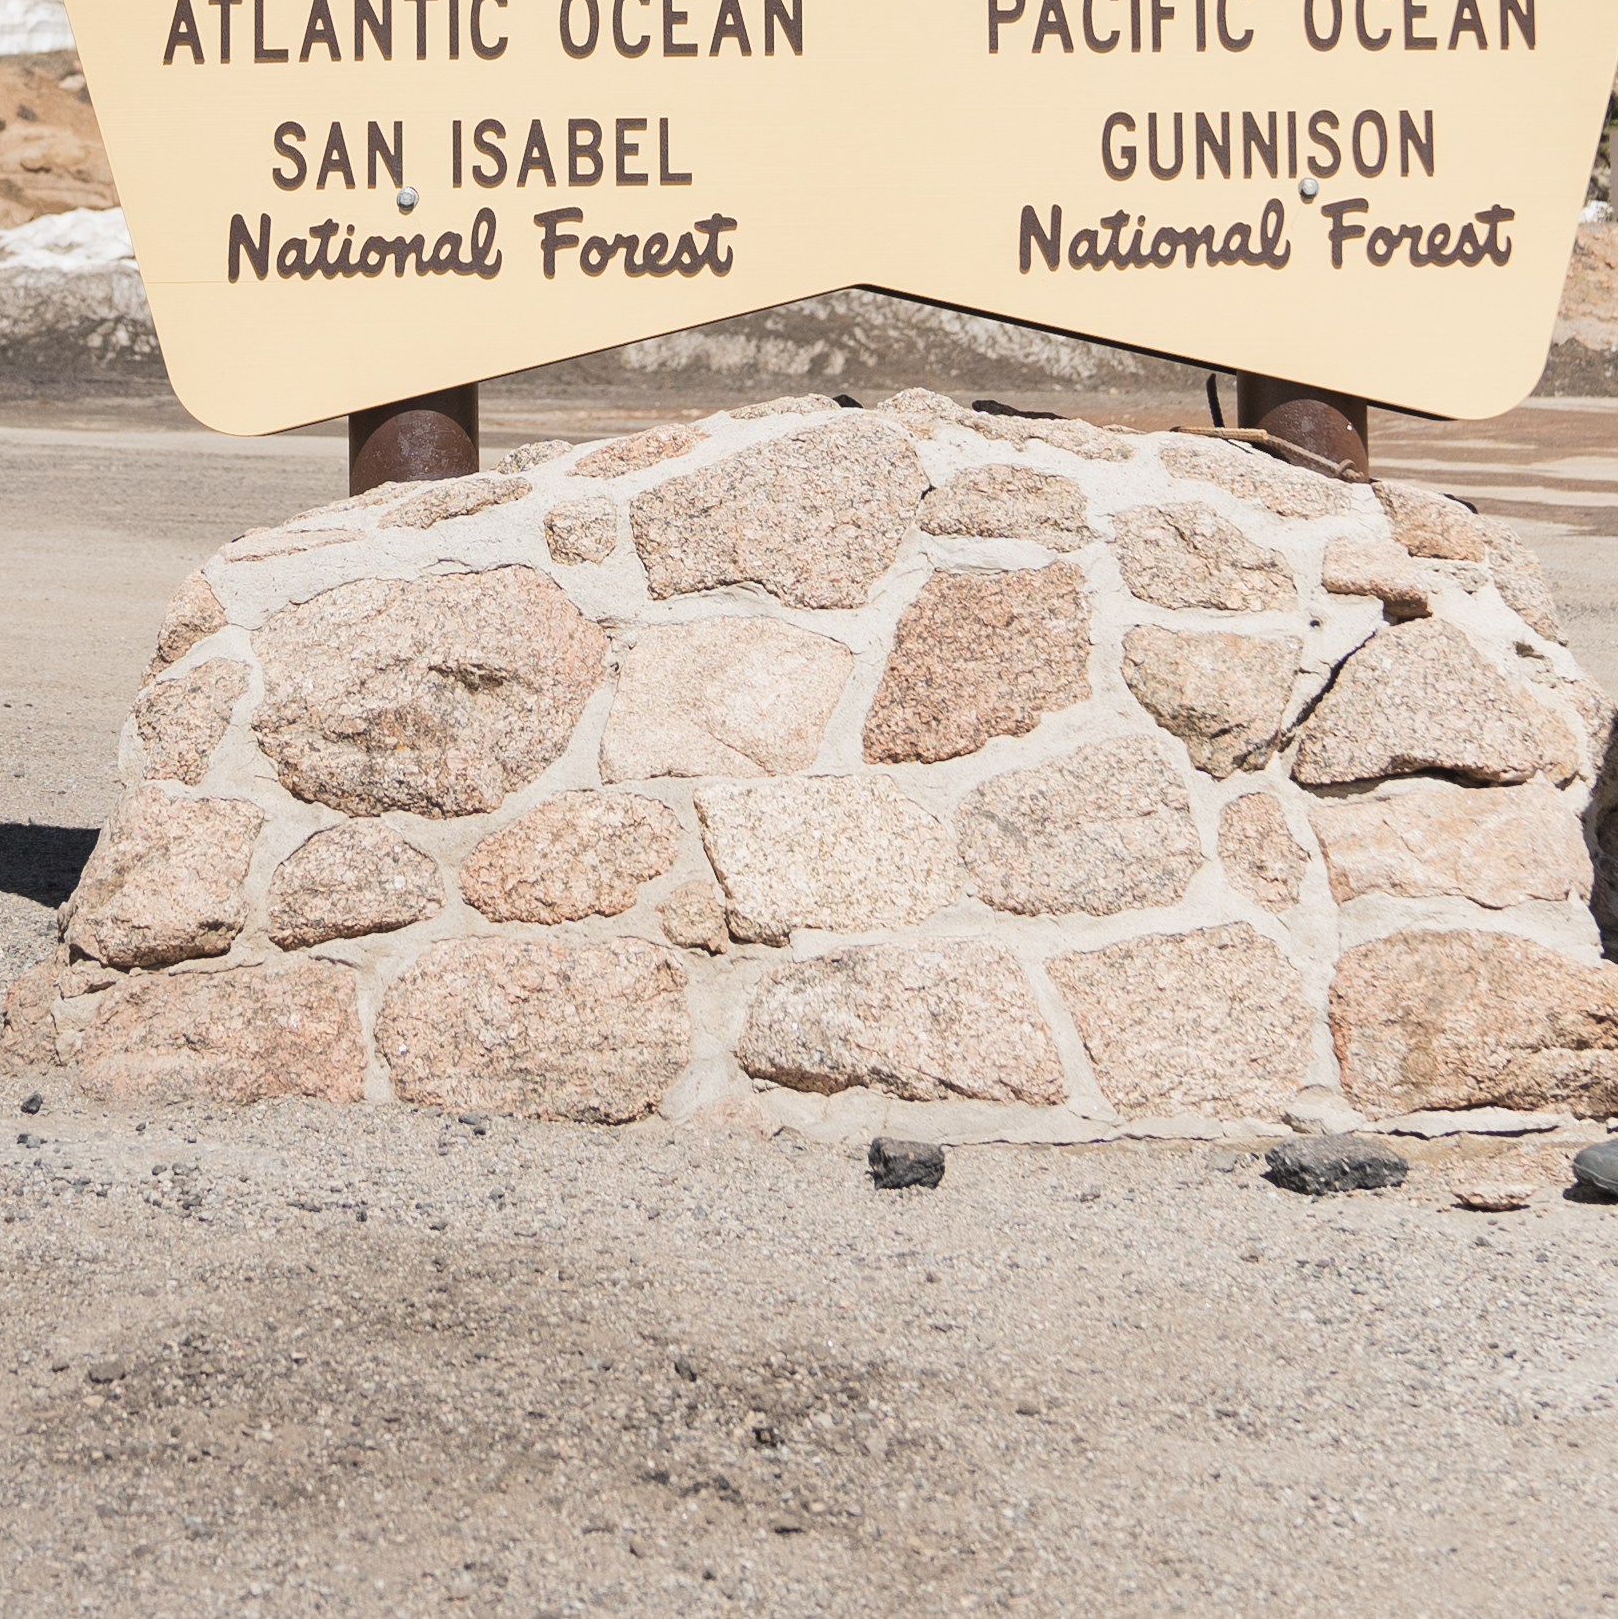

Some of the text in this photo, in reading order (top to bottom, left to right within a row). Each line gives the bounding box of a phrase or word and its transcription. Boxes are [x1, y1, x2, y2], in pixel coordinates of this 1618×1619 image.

[273, 118, 692, 190] SAN ISABEL
[1102, 110, 1434, 181] GUNNISON
[228, 207, 737, 283] National Forest
[1019, 198, 1515, 274] National Forest
